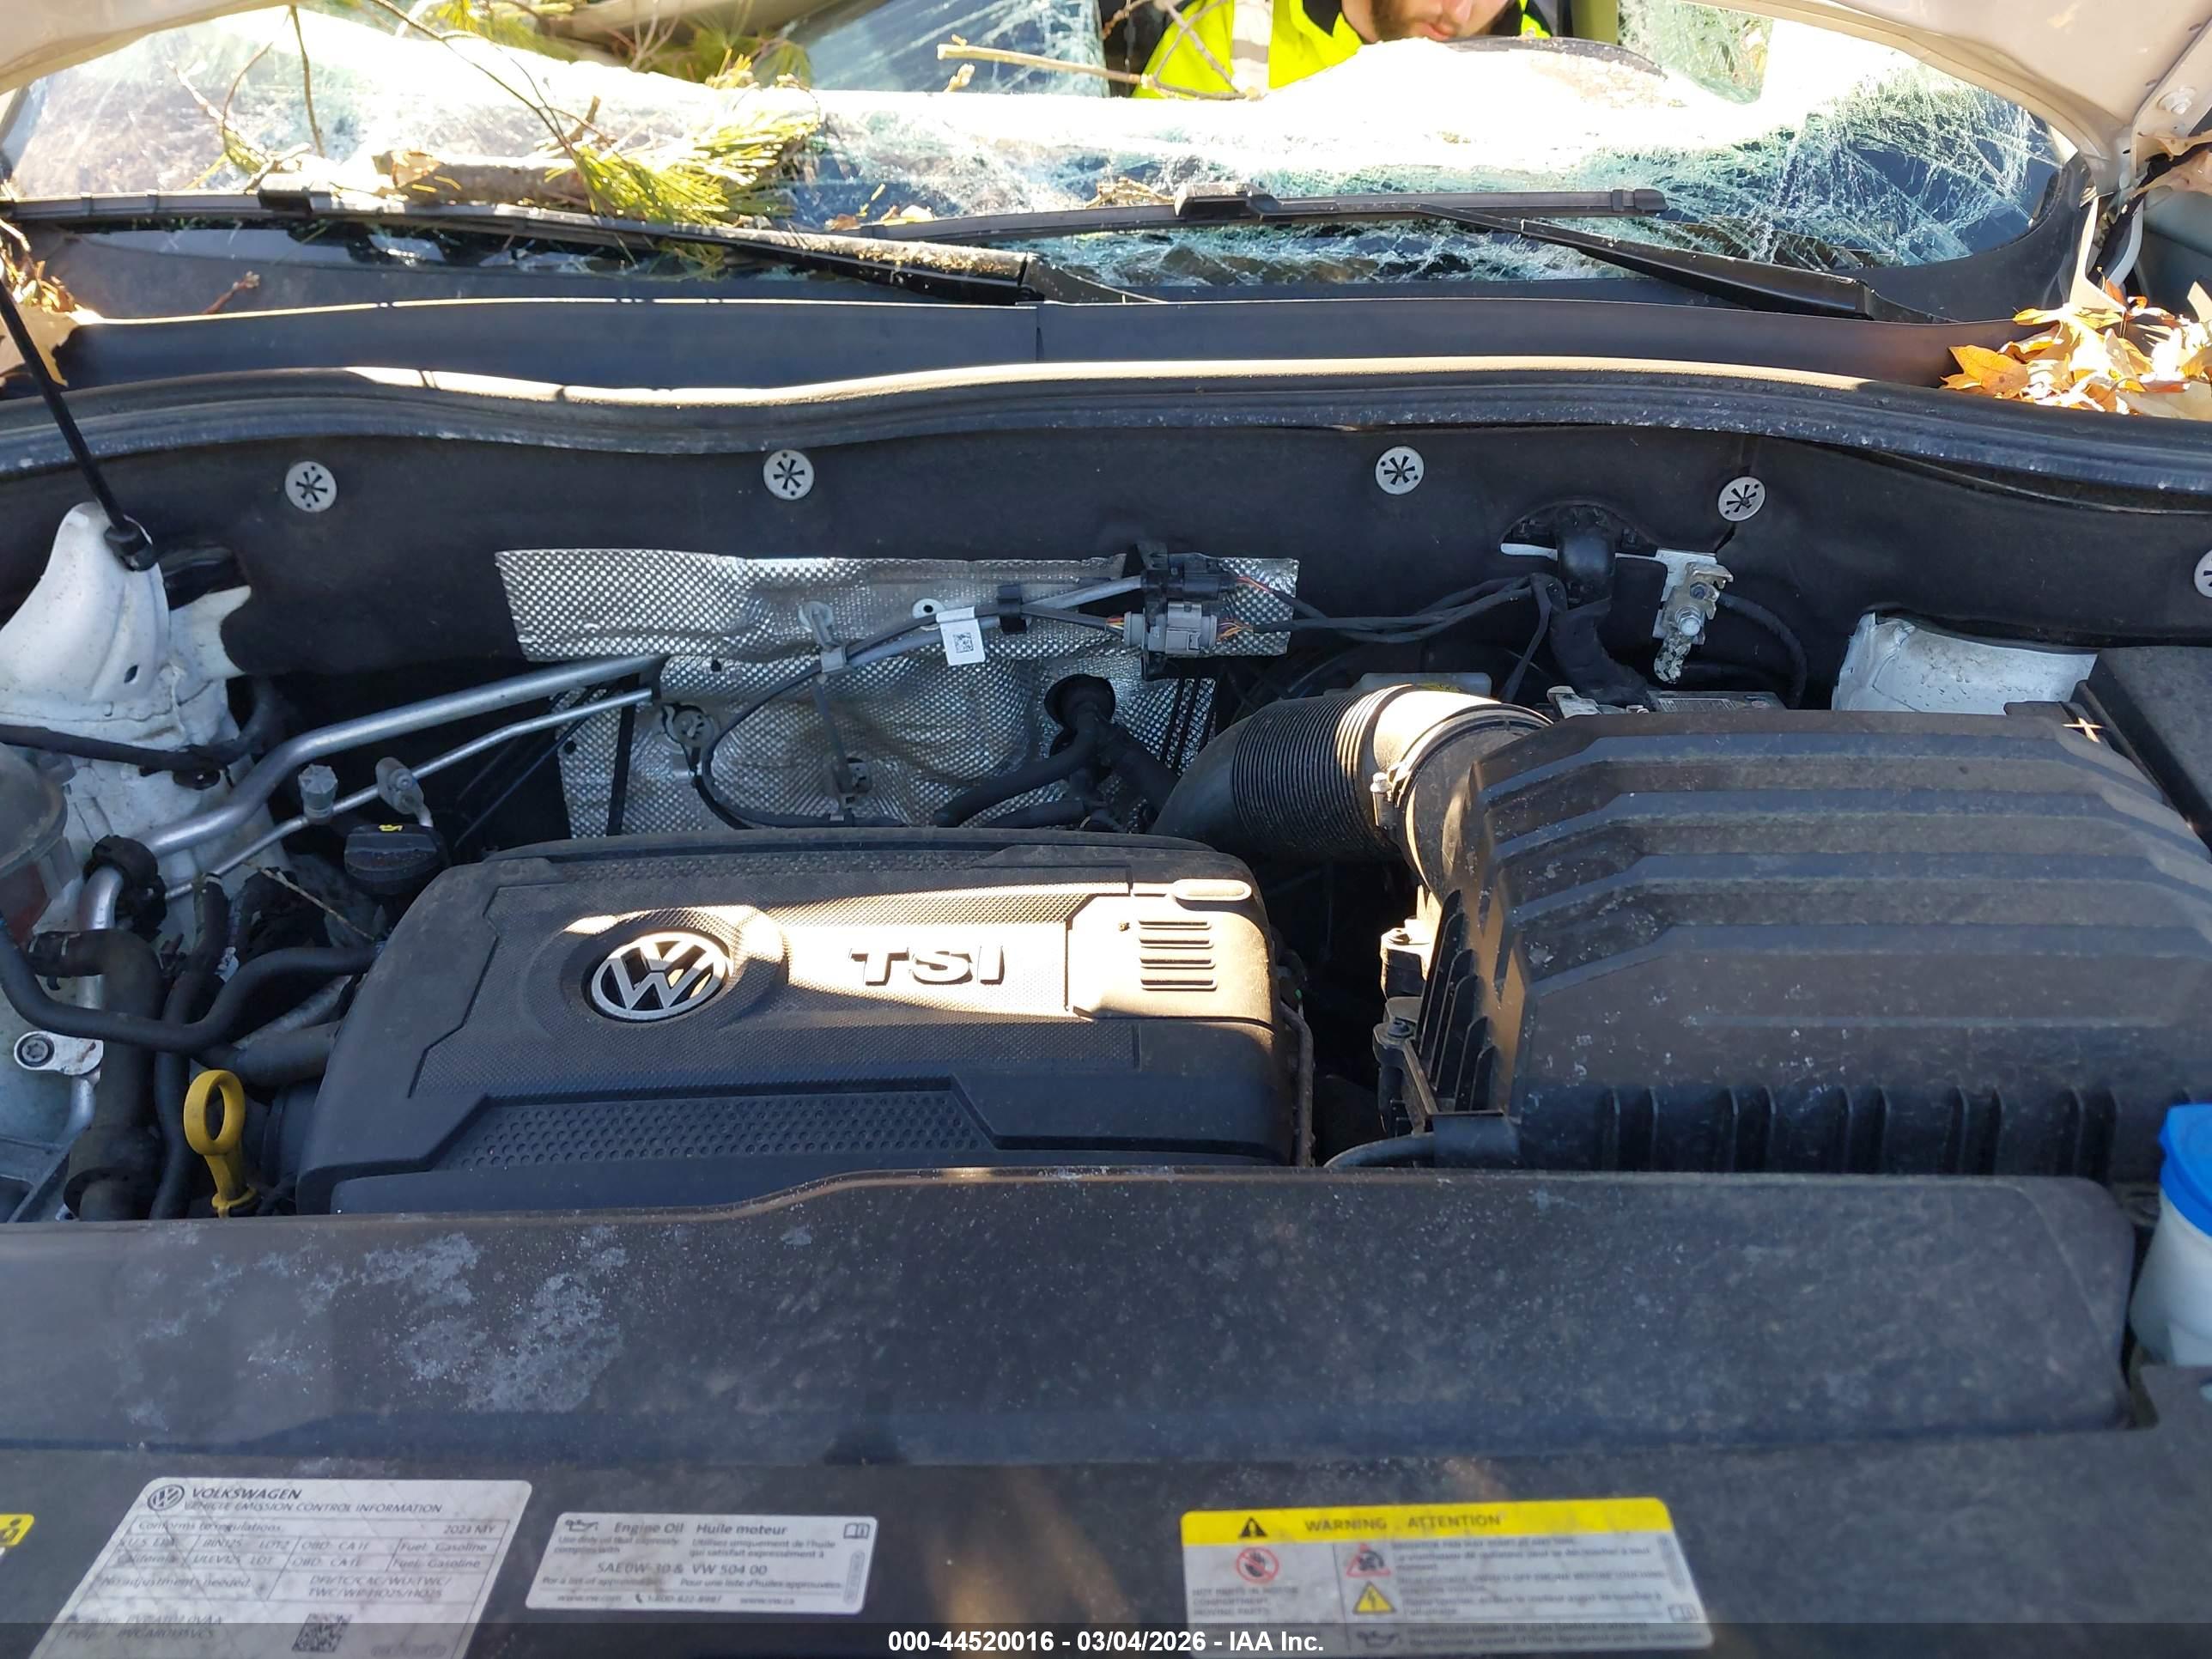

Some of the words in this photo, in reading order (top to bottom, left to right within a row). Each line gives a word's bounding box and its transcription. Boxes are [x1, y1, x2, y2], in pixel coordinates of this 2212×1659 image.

[849, 945, 1005, 987] TSI
[191, 1487, 303, 1501] VOLKSWAGEN
[184, 1501, 232, 1510] VEHICLE
[234, 1502, 292, 1511] EMISSION
[295, 1503, 351, 1512] CONTROL
[356, 1504, 443, 1513] INFORMATION
[139, 1522, 195, 1531] Conforms
[474, 1524, 496, 1534] MY
[613, 1522, 661, 1535] Engine
[663, 1522, 684, 1534] Oil
[1304, 1517, 1388, 1532] WARNING
[1407, 1514, 1502, 1528] ATTENTION
[696, 1523, 732, 1534] Huile
[735, 1524, 788, 1536] moteur
[434, 1542, 488, 1553] Gasoline
[729, 1540, 789, 1549] uniquement
[793, 1540, 805, 1548] de
[707, 1549, 746, 1558] satisfait
[427, 1558, 482, 1568] Gasoline
[597, 1562, 624, 1574] SAE
[692, 1564, 716, 1575] VW
[720, 1564, 746, 1575] 504
[749, 1564, 769, 1576] 00
